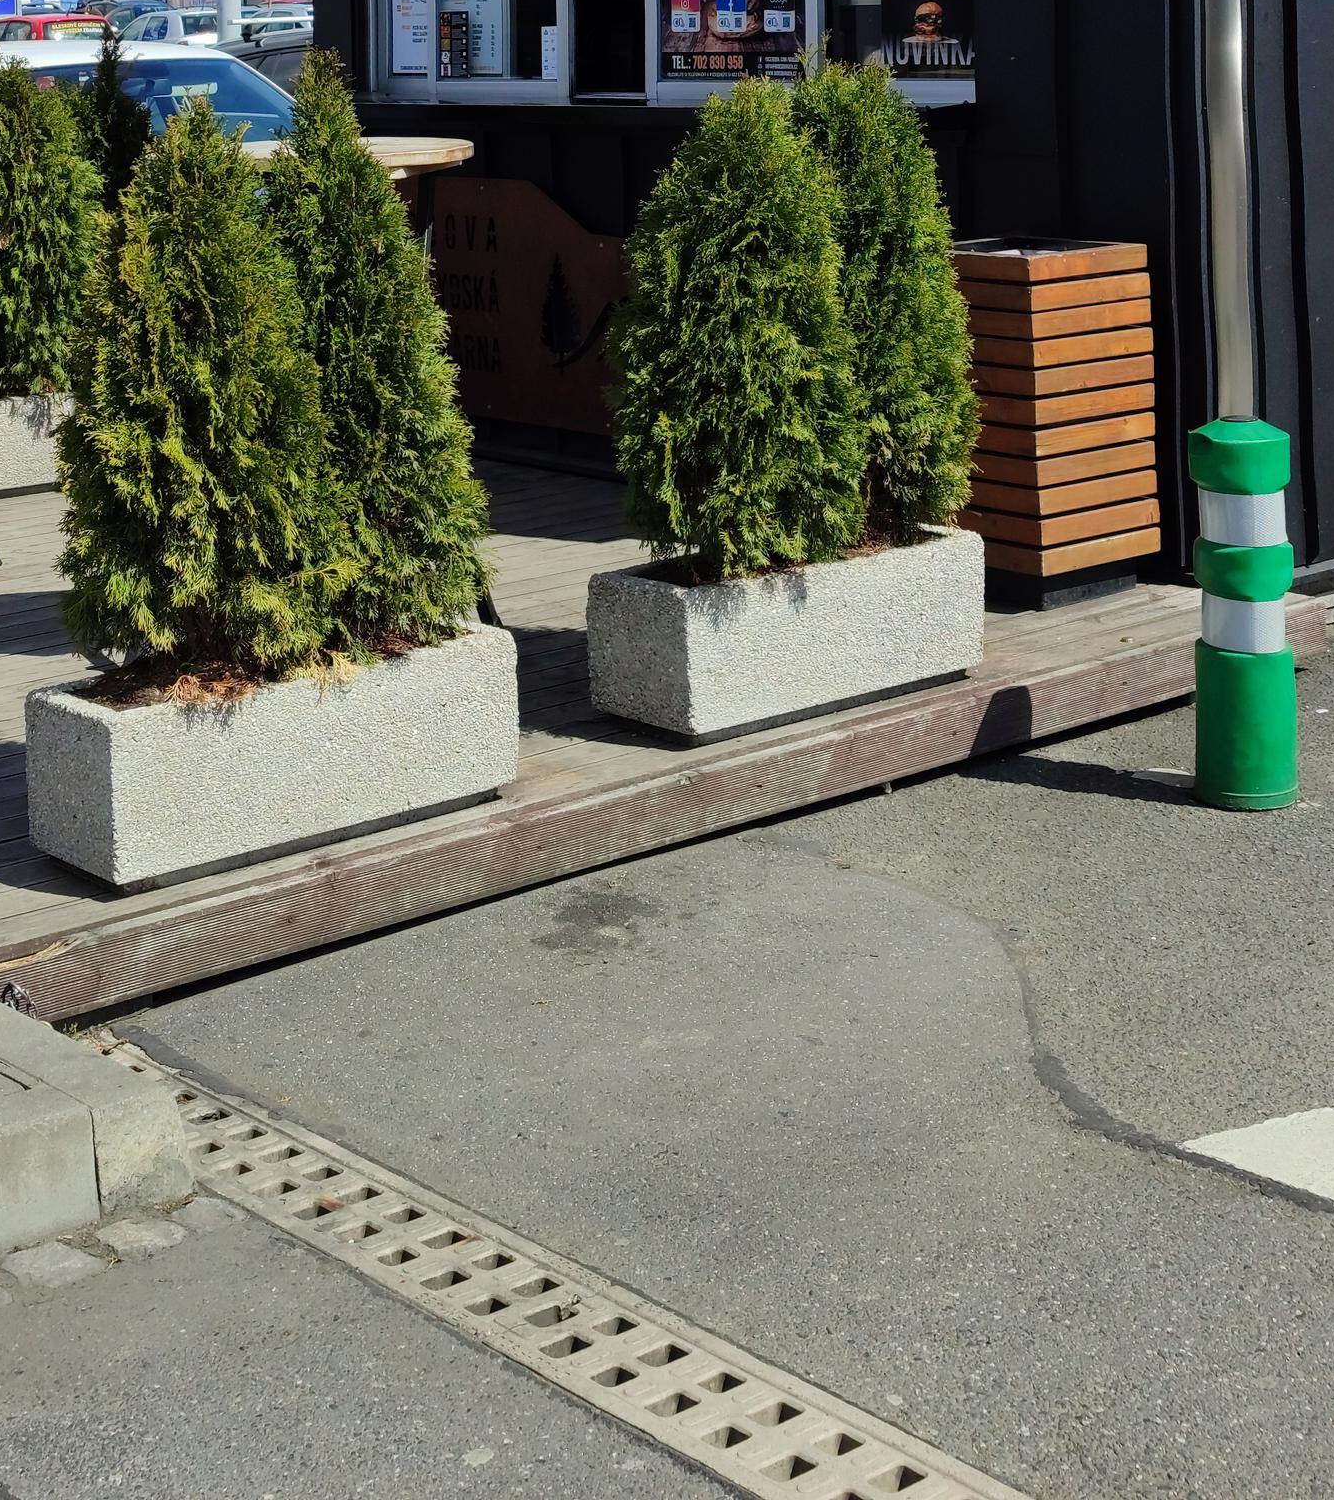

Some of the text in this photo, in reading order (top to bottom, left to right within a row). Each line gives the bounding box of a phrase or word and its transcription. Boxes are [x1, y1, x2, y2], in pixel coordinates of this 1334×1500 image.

[671, 54, 744, 69] TEL.: 702 830 958
